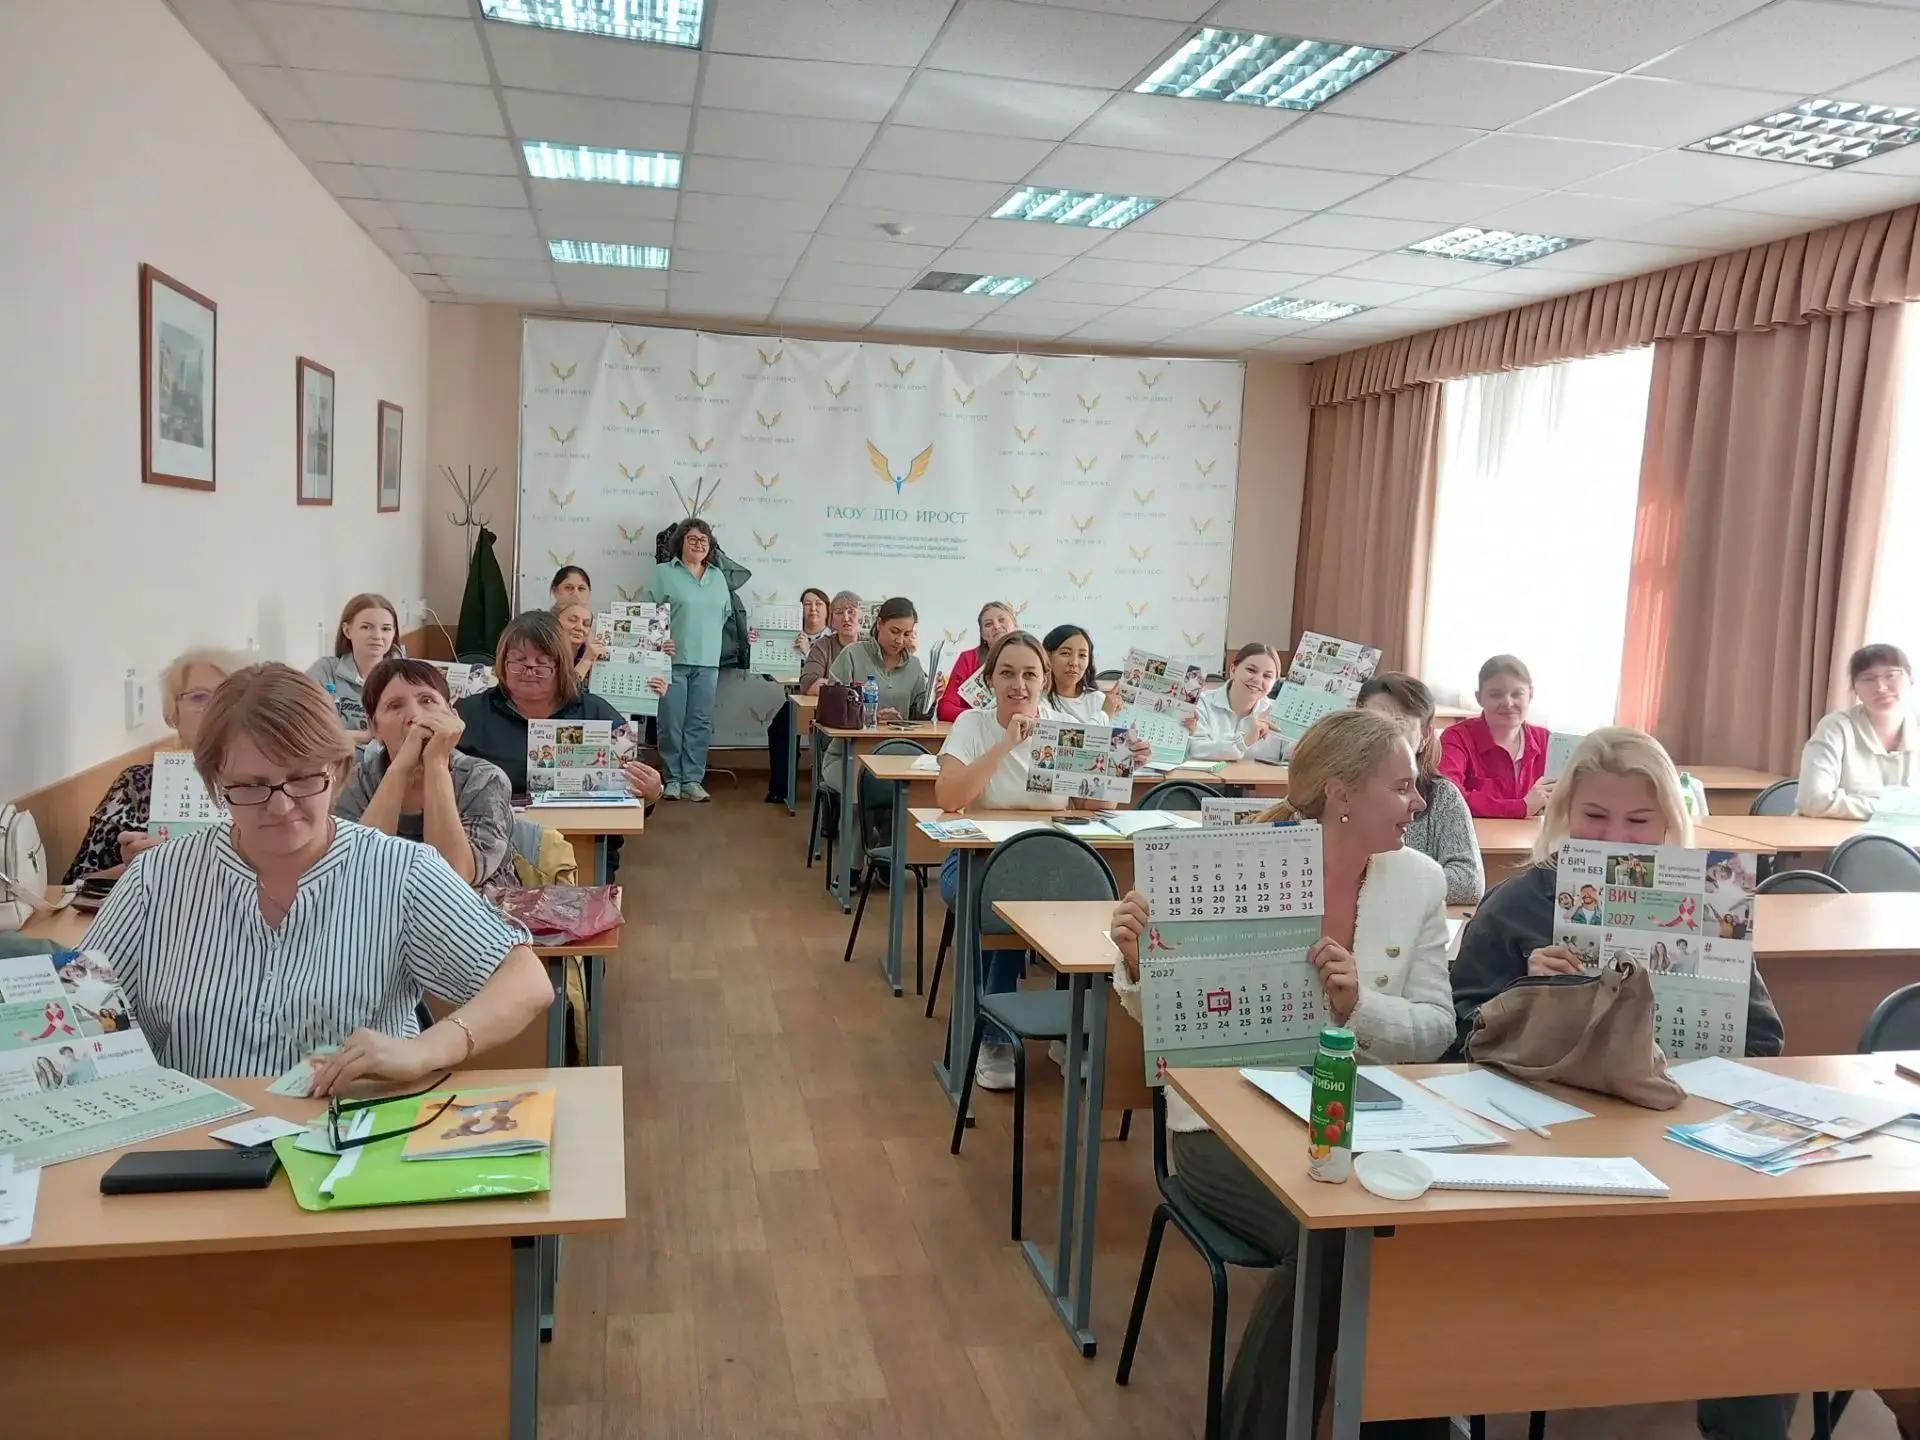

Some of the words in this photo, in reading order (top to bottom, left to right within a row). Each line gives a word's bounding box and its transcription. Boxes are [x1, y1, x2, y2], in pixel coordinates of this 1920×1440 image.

[826, 505, 866, 520] ГАОУ
[873, 508, 908, 521] ДПО
[916, 510, 968, 524] ИРОСТ
[1145, 842, 1170, 851] 2027
[1303, 857, 1309, 865] 3
[1568, 857, 1585, 866] ВИЧ
[1588, 866, 1603, 875] БЕЗ
[1280, 892, 1292, 900] 23
[1609, 888, 1636, 904] ВИЧ
[1607, 913, 1635, 926] 2027
[1150, 969, 1174, 978] 2027
[1283, 981, 1288, 989] 6
[1217, 998, 1228, 1006] 10
[1725, 1012, 1732, 1020] 6
[1218, 1021, 1230, 1029] 24
[1673, 1017, 1685, 1025] 11
[1697, 1020, 1710, 1028] 12
[1722, 1023, 1734, 1031] 13
[1721, 1034, 1733, 1042] 20
[1695, 1042, 1708, 1051] 26
